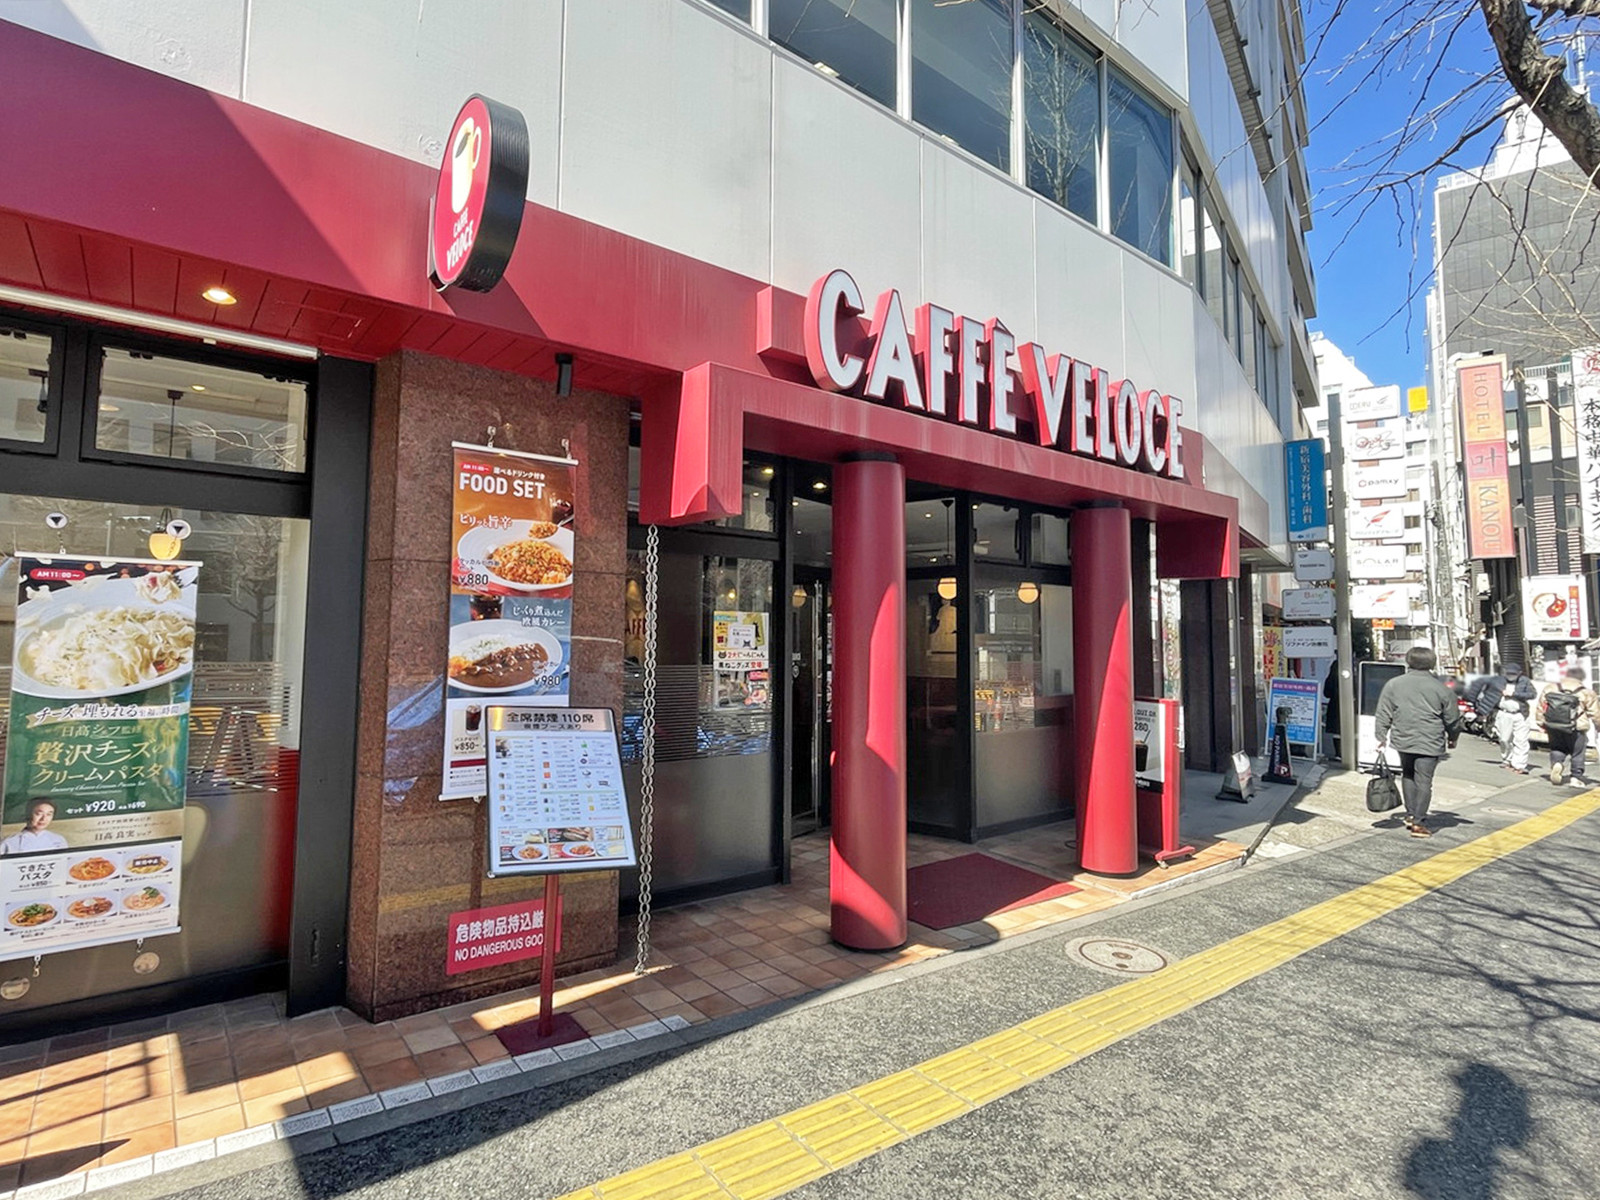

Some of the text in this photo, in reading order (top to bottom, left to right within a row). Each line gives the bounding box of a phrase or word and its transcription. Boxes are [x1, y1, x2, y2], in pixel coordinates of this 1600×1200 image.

[447, 219, 473, 272] VELOCE
[1474, 372, 1490, 434] HOTEL
[1018, 342, 1184, 478] VELOCE
[459, 472, 545, 499] FOOD SET
[1478, 485, 1500, 550] KANOU
[37, 569, 49, 577] AM
[459, 573, 489, 586] ¥880
[513, 604, 564, 618] じっくり煮込んだ
[522, 616, 566, 627] 欧風カレー
[534, 674, 561, 686] ¥980
[506, 712, 594, 723] 全席禁煙 110席
[32, 764, 164, 786] クリームパスタ
[85, 800, 116, 812] ¥920
[17, 862, 56, 873] できたて
[20, 871, 52, 881] パスタ
[454, 948, 469, 962] NO
[470, 937, 524, 958] DANGEROUS
